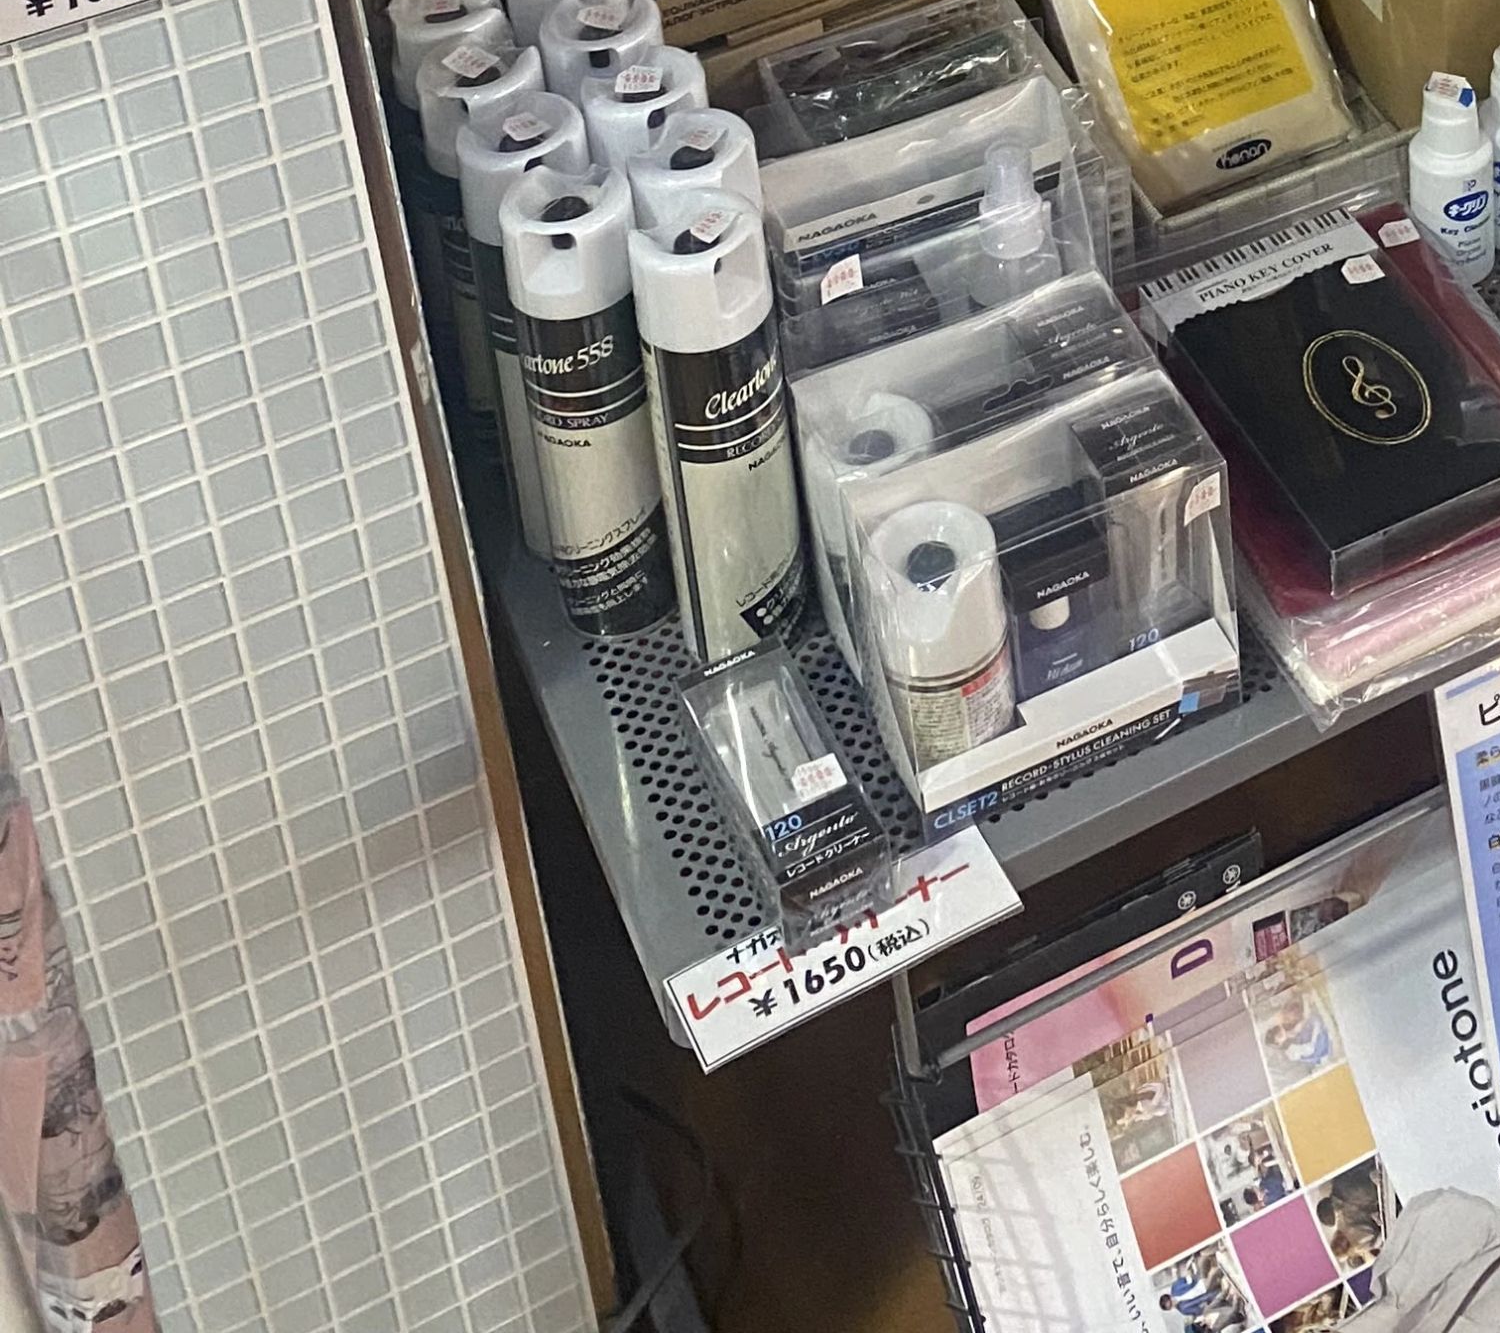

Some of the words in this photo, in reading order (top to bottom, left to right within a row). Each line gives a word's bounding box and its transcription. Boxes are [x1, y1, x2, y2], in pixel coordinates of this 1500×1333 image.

[798, 211, 878, 243] NAGAOKA
[1198, 275, 1248, 305] PIANO
[1248, 266, 1281, 292] KEY
[1280, 241, 1334, 277] COVER
[577, 335, 614, 371] 558
[567, 412, 609, 429] SPRAY
[1129, 458, 1179, 484] NAGAOKA
[1037, 570, 1091, 599] NAGAOKA
[703, 649, 756, 677] NAGAOKA
[1056, 717, 1114, 750] NAGAOKA
[1092, 720, 1151, 755] CLEANING
[1151, 708, 1172, 728] SET
[766, 813, 802, 840] 120
[933, 790, 999, 831] CLSET2
[809, 865, 864, 901] NAGAOKA
